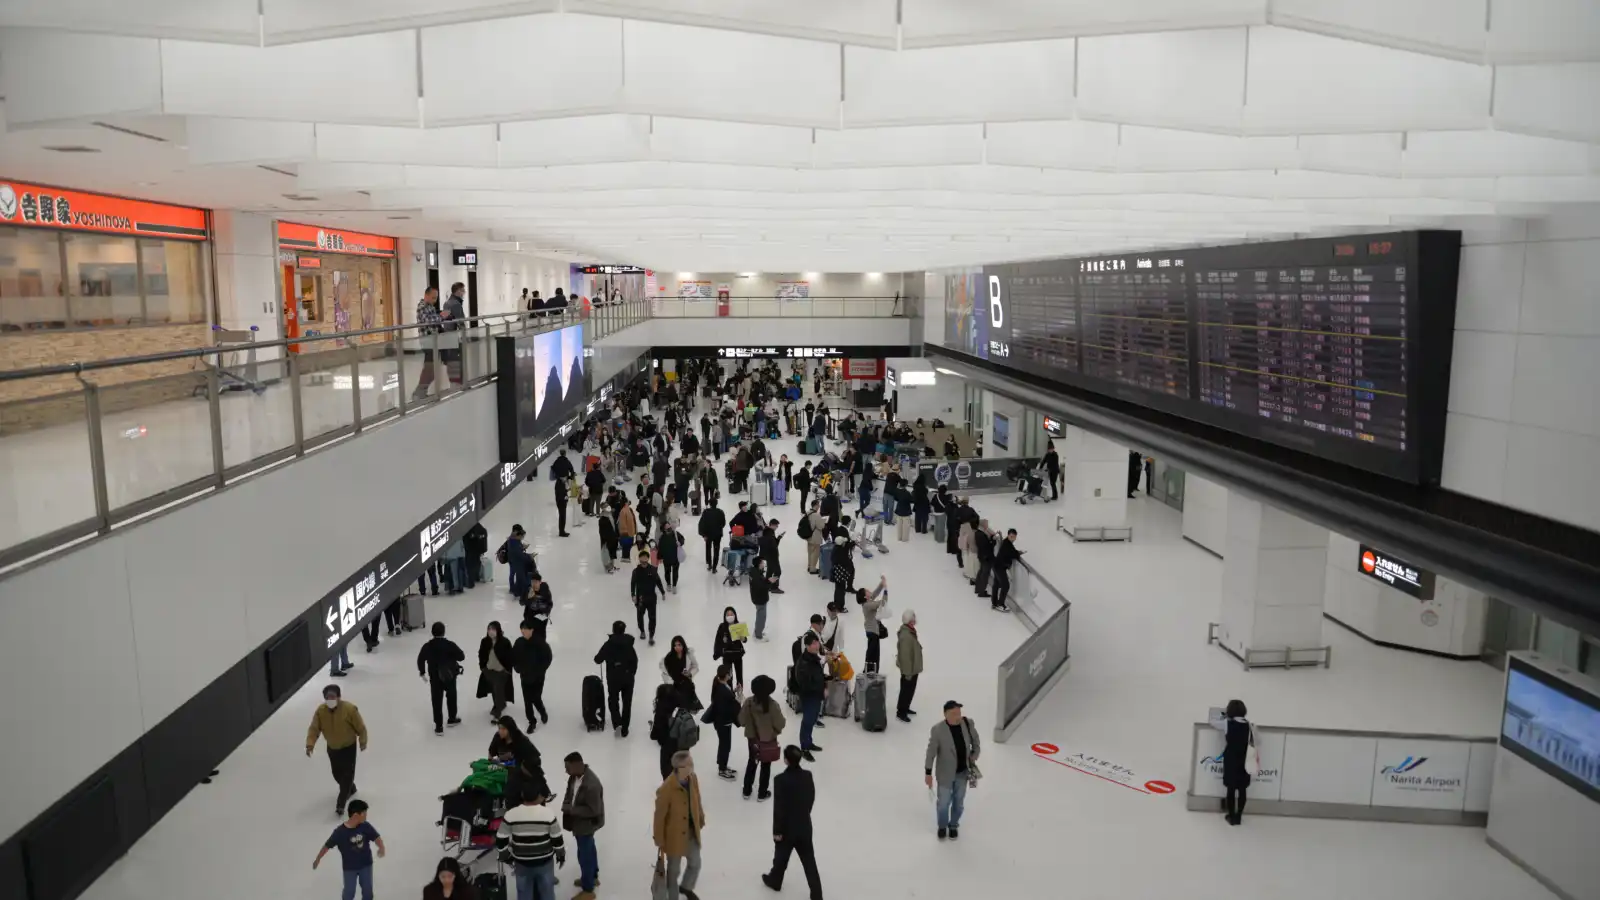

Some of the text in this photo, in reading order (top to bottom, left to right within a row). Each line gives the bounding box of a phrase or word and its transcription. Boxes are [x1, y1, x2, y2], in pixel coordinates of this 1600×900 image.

[20, 191, 71, 225] 吉野家
[72, 211, 132, 232] YOSHINOYA
[989, 275, 1003, 328] B
[1375, 556, 1405, 576] 入れません
[356, 571, 376, 601] 国内線
[357, 592, 381, 622] Domestic
[1390, 775, 1461, 786] Narita Airport
